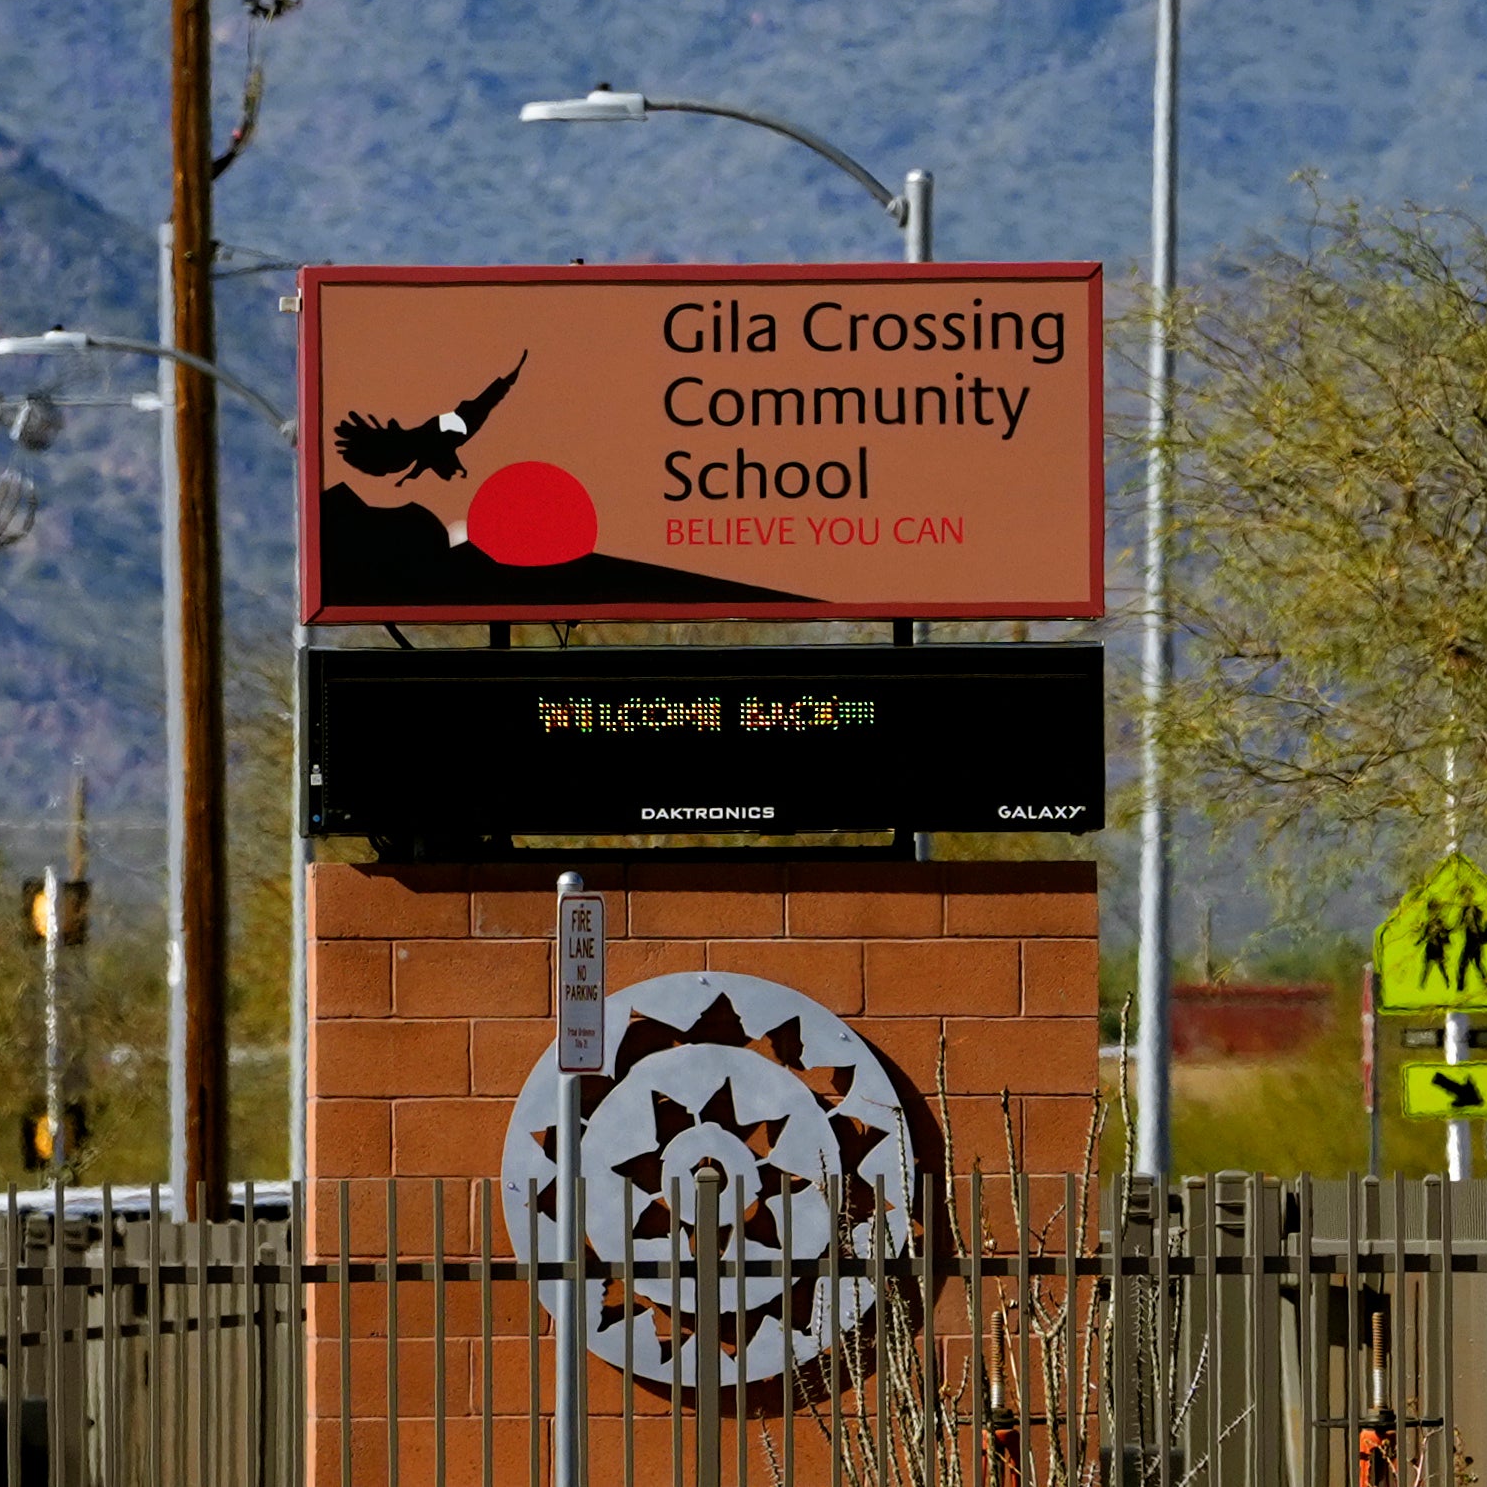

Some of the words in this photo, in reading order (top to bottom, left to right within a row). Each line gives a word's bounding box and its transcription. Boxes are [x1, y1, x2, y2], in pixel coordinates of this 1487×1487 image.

[663, 299, 777, 353] Gila
[802, 298, 1065, 364] Crossing
[663, 372, 1030, 440] Community
[663, 446, 868, 502] School
[665, 517, 796, 546] BELIEVE
[807, 517, 881, 546] YOU
[893, 516, 964, 545] CAN
[538, 696, 721, 733] WELCOME
[641, 806, 775, 820] DAKTRONICS
[997, 805, 1082, 820] GALAXY
[571, 909, 592, 932] FIRE
[568, 937, 595, 959] LANE
[577, 964, 587, 982] NO
[565, 984, 598, 1001] PARKING
